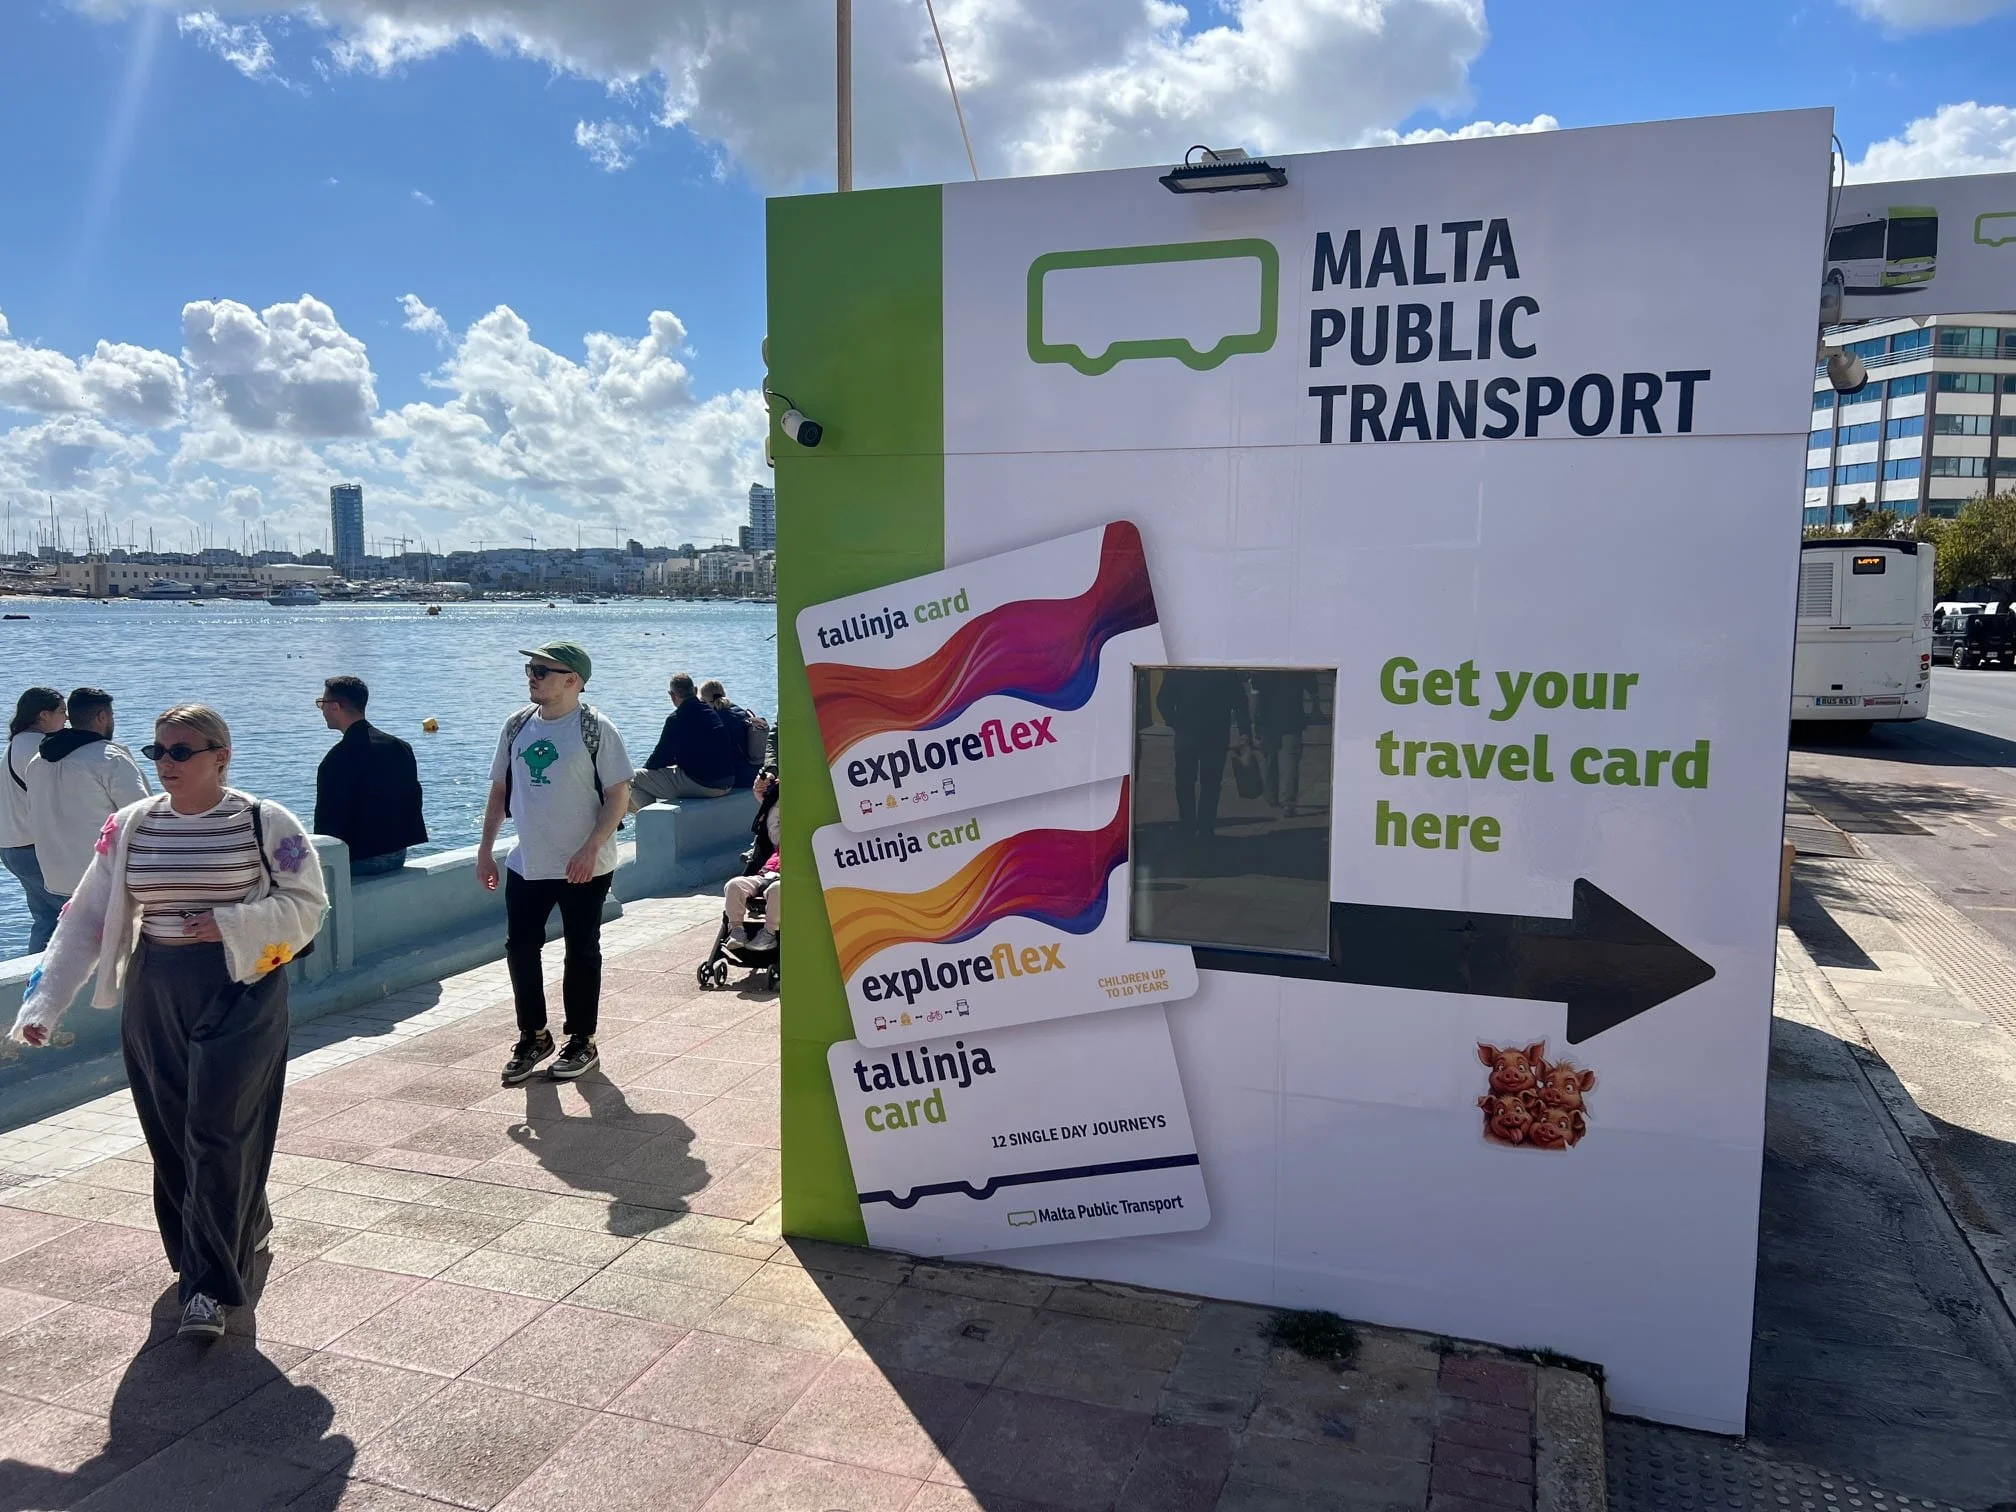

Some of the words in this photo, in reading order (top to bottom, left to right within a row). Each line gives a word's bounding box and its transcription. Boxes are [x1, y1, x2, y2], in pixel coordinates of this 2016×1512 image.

[1311, 218, 1520, 293] MALTA
[1309, 296, 1541, 369] PUBLIC
[1308, 369, 1712, 444] TRANSPORT
[817, 607, 909, 648] tallinja
[913, 588, 970, 623] card
[1379, 656, 1481, 707] Get
[1488, 670, 1640, 722] your
[847, 716, 1057, 788] exploreflex
[1375, 729, 1554, 783] travel
[1570, 739, 1711, 790] card
[833, 833, 922, 870] tallinja
[926, 818, 981, 850] card
[1375, 799, 1502, 853] here
[862, 942, 1066, 1005] exploreflex
[1097, 971, 1150, 988] CHILDREN
[1151, 968, 1166, 980] UP
[1105, 987, 1120, 998] TO
[1122, 986, 1134, 996] 10
[1135, 980, 1169, 994] YEARS
[853, 1040, 996, 1093] tallinja
[864, 1087, 947, 1132] card
[991, 1134, 1007, 1149] 12
[1009, 1128, 1059, 1147] SINGLE
[1061, 1123, 1088, 1140] DAY
[1092, 1114, 1167, 1137] JOURNEYS
[1039, 1208, 1076, 1223] Malta
[1078, 1201, 1119, 1219] Public
[1119, 1194, 1184, 1216] Transport
